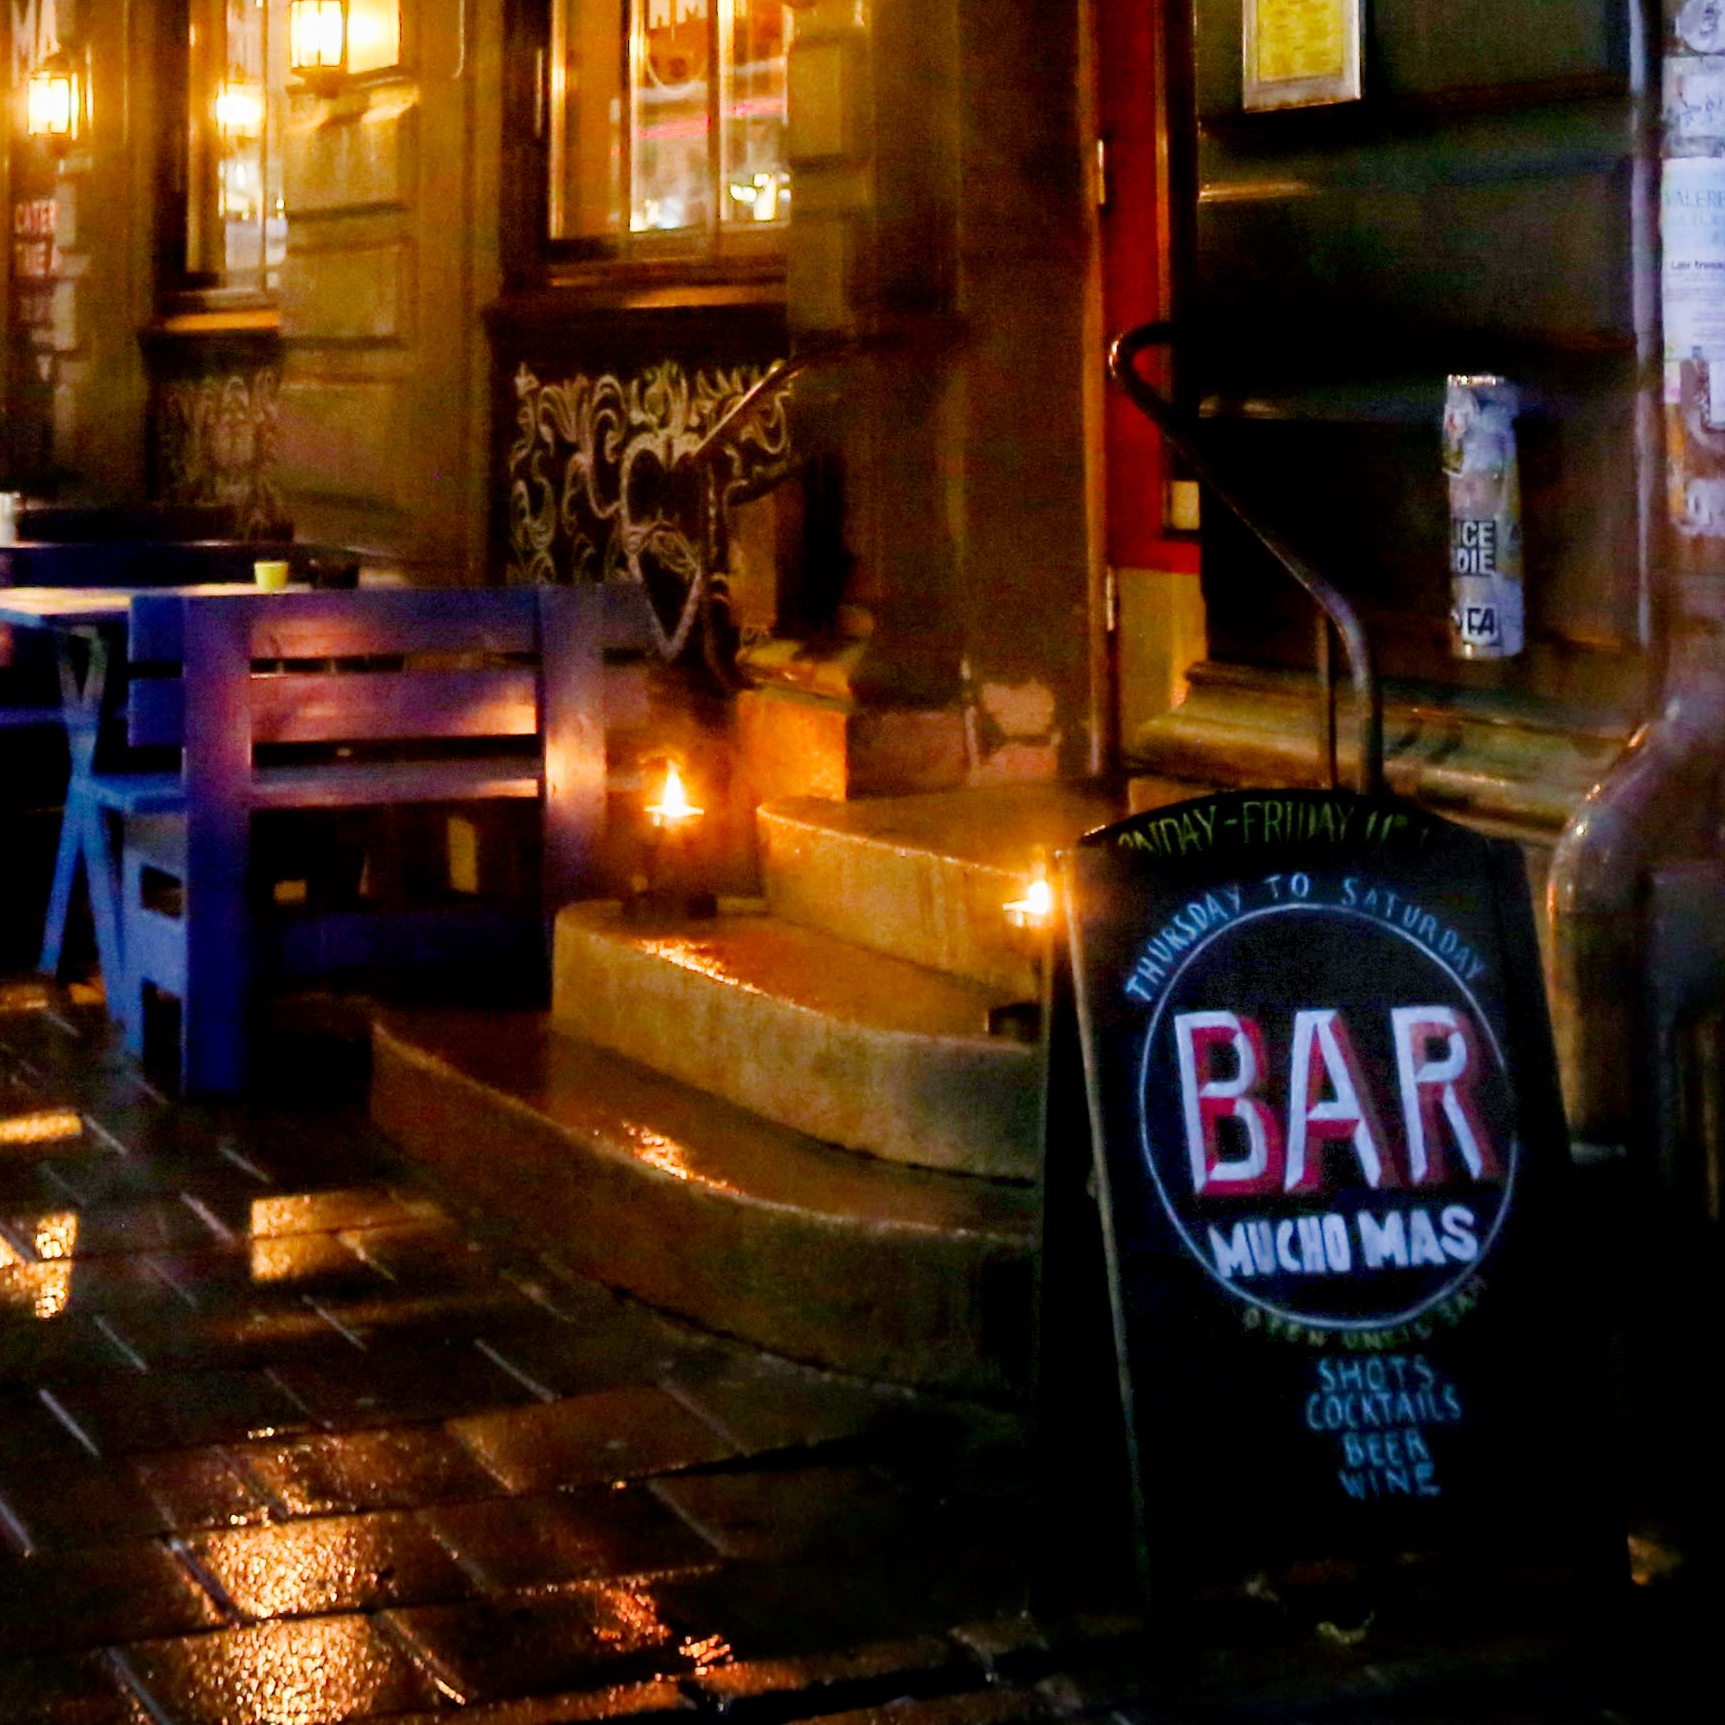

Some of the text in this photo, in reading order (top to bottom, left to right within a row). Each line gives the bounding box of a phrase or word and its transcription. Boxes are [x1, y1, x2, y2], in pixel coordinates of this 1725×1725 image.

[1123, 872, 1490, 1004] THURSDAY TO SATURDAY
[1174, 1006, 1504, 1196] BAR
[1207, 1204, 1478, 1278] MUCHO MAS
[1316, 1355, 1436, 1393] SHOTS
[1305, 1383, 1463, 1431] COCKTAILS
[1342, 1429, 1431, 1468] BEER
[1337, 1462, 1442, 1502] WINE
